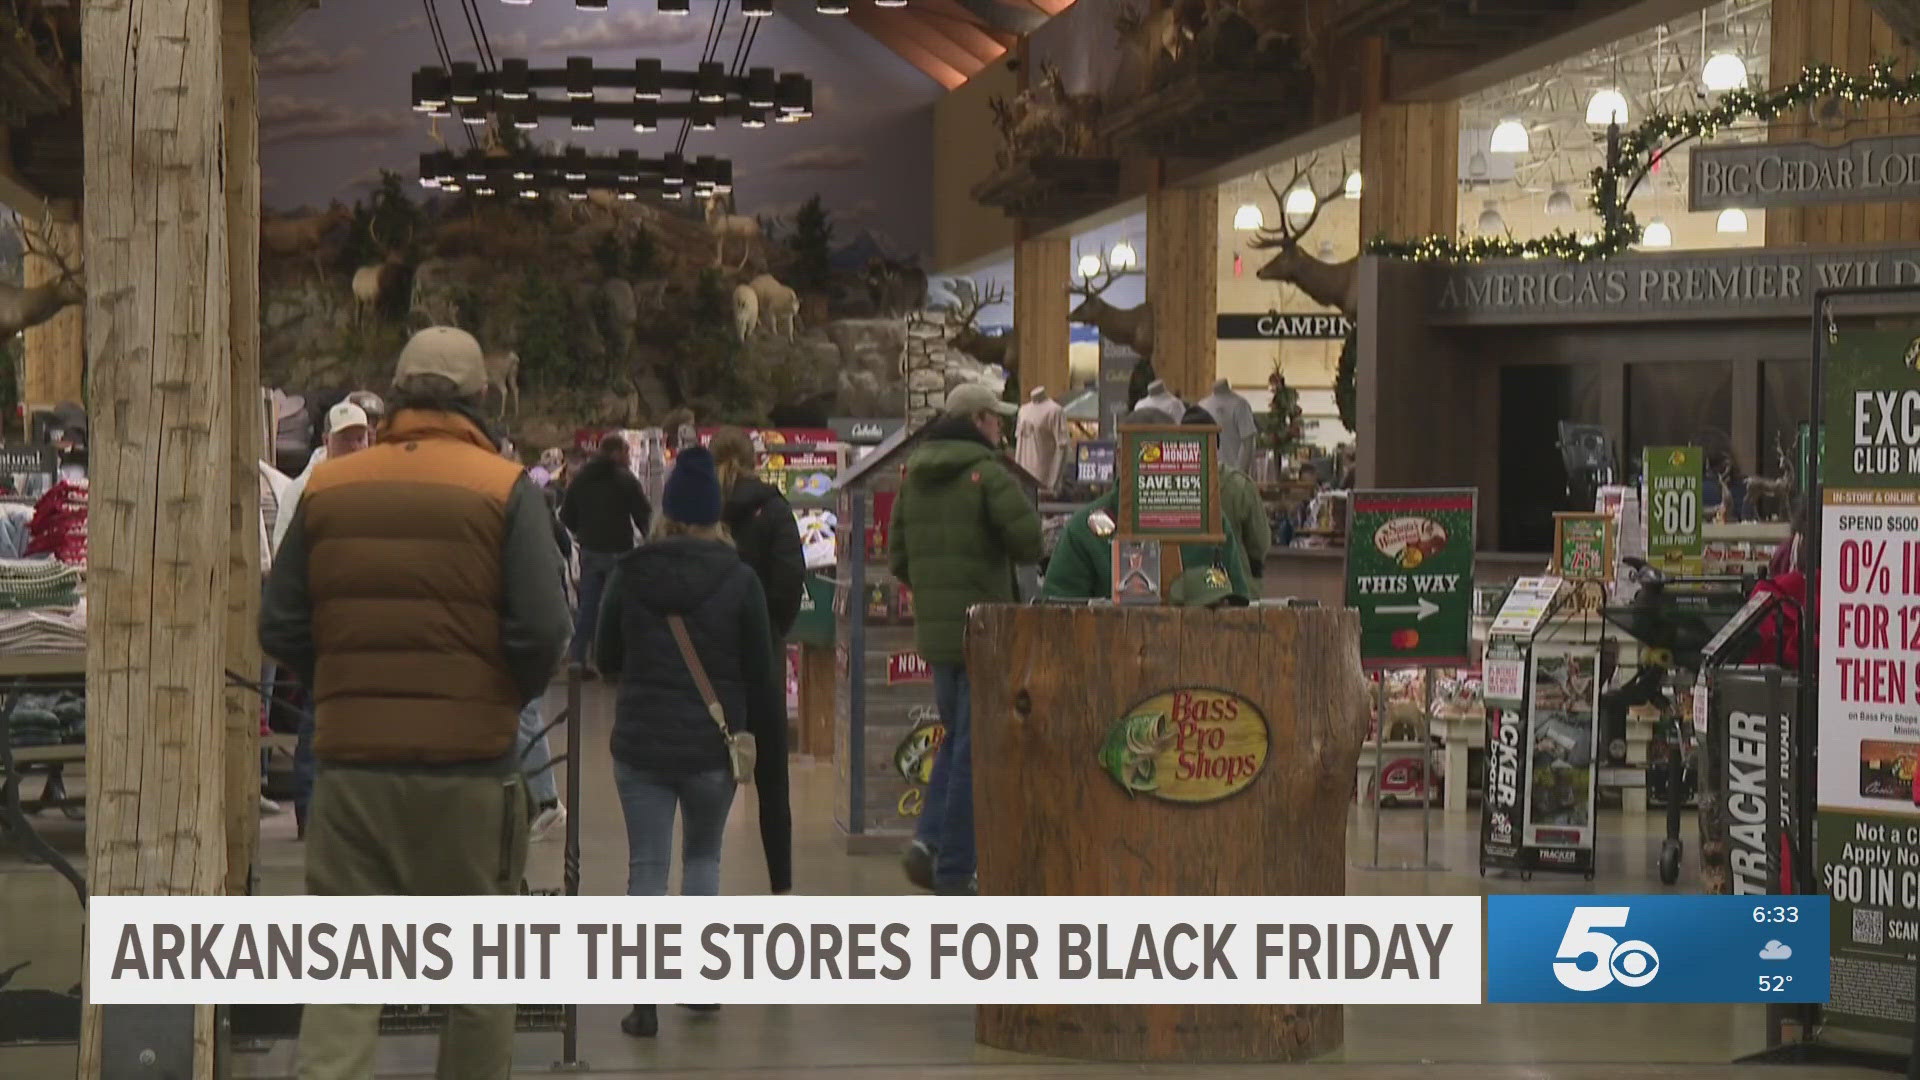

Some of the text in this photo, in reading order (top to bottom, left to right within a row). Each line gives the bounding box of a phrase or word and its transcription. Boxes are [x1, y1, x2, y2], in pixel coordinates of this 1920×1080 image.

[1701, 160, 1750, 196] BIG
[1755, 156, 1854, 192] CEDAR
[1439, 270, 1628, 307] AMERICA'S
[1639, 264, 1801, 302] PREMIER
[1854, 447, 1900, 474] CLUB
[1139, 475, 1200, 490] SAVE 15%
[1654, 475, 1697, 490] EARN UP TO
[1884, 490, 1915, 504] ONLINE
[1653, 489, 1696, 534] $60
[1839, 515, 1919, 532] SPEND $500
[1840, 539, 1890, 595] 0%
[1357, 573, 1460, 594] THIS WAY
[1838, 604, 1889, 649] FOR
[899, 653, 927, 673] NOW
[1836, 657, 1906, 704] THEN
[1171, 690, 1239, 723] Bass
[1848, 711, 1918, 724] on Bass Pro Shops
[1175, 720, 1226, 752] Pro
[1175, 751, 1257, 786] Shops
[1728, 710, 1767, 895] TRACKER
[1856, 822, 1885, 842] Not
[1891, 828, 1900, 844] a
[1539, 850, 1577, 862] TRACKER
[1842, 842, 1891, 867] Apply
[1824, 862, 1863, 903] $60
[1870, 867, 1894, 907] IN
[1888, 920, 1919, 941] SCAN
